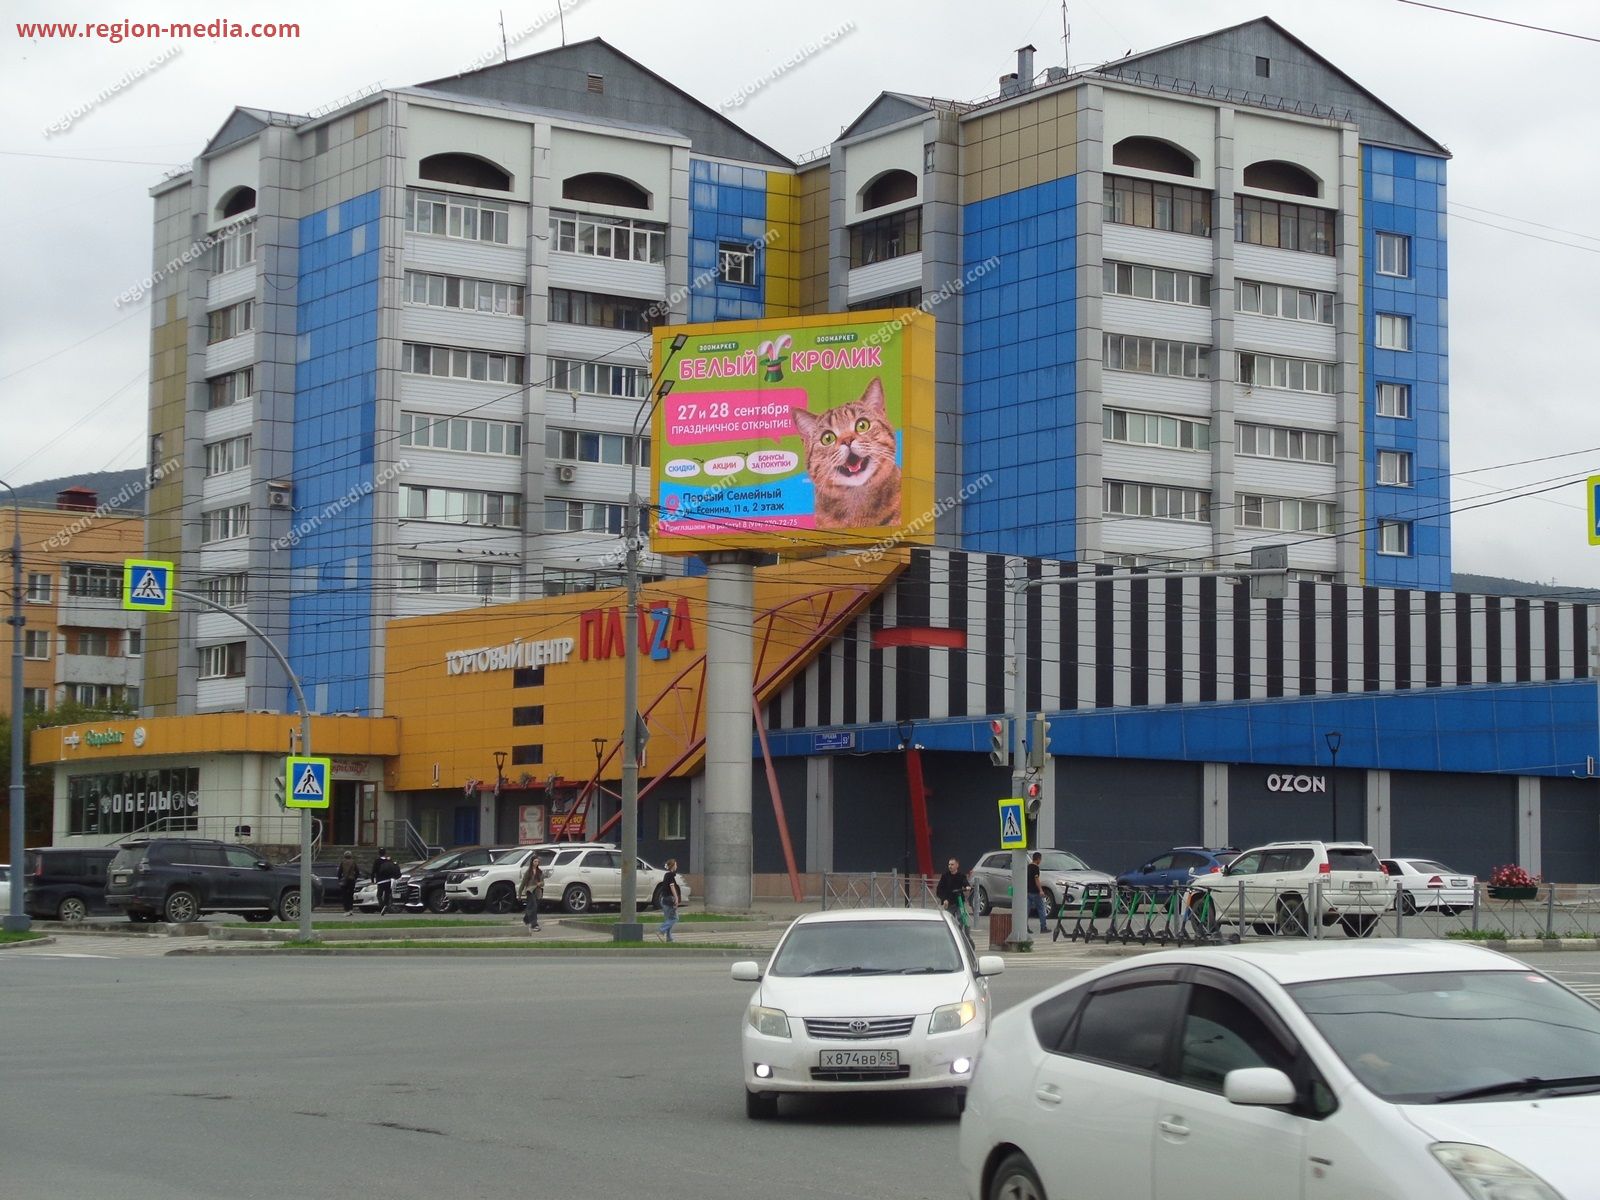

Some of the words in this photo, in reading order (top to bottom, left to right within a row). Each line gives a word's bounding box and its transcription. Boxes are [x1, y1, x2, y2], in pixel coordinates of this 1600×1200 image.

[817, 334, 855, 343] ЗООМАРКЕТ
[699, 342, 736, 351] ЗООМАРКЕТ
[679, 349, 758, 380] БЕЛЫЙ
[791, 345, 882, 373] КРОЛИК
[677, 404, 697, 420] 27
[699, 410, 706, 419] и
[709, 402, 729, 418] 28
[734, 403, 789, 417] сентября
[671, 422, 739, 435] ПРАЗДНИЧНОЕ
[741, 419, 792, 431] ОТКРЫТИЕ!
[668, 464, 696, 473] СКИДКИ
[712, 462, 737, 471] АКЦИИ
[761, 461, 791, 469] ПОКУПКИ
[683, 490, 724, 504] Первый
[726, 488, 782, 501] Семейный
[696, 505, 731, 515] Есенина,
[734, 503, 741, 512] 11
[753, 503, 759, 511] 2
[760, 501, 785, 512] этаж
[446, 637, 525, 676] ТОРГОВЫЙ
[525, 637, 574, 671] ЦЕНТР
[1267, 773, 1326, 793] OZON
[112, 790, 171, 814] ОБЕДЫ
[879, 1051, 893, 1062] 65
